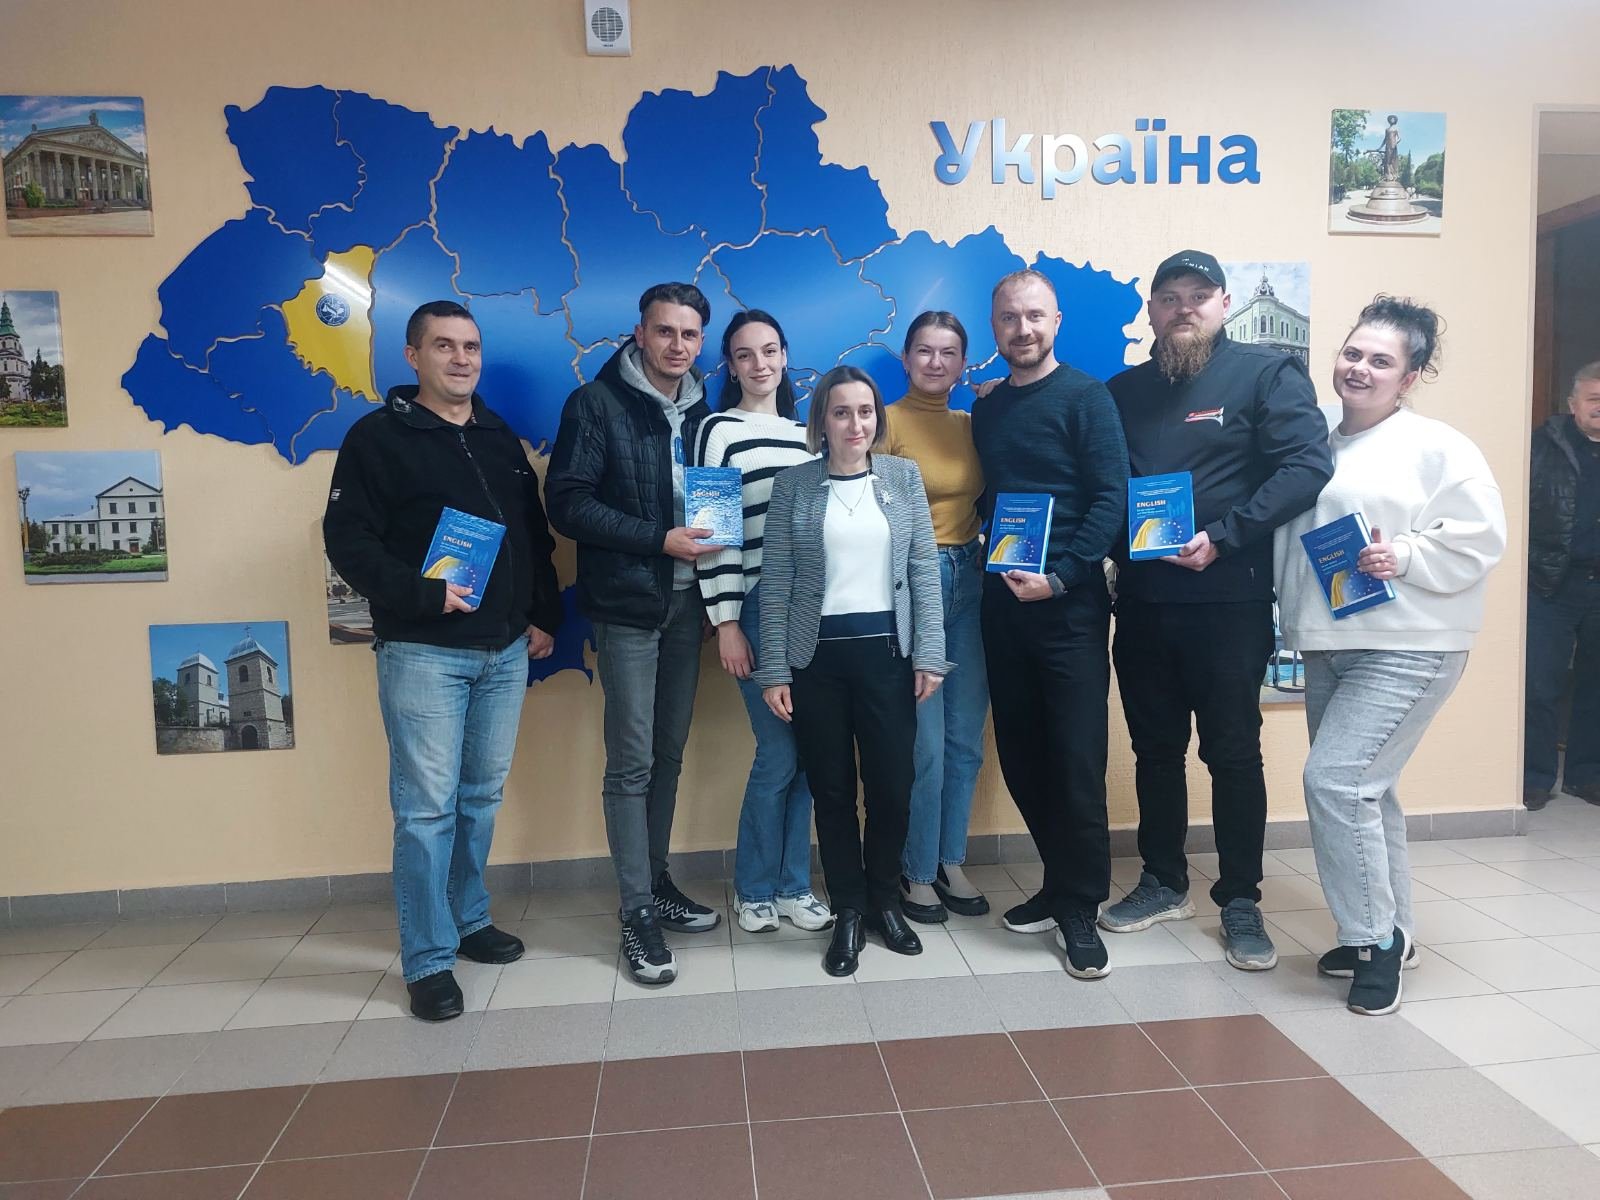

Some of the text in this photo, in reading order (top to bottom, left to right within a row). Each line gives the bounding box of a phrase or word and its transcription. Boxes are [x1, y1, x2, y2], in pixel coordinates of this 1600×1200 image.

[929, 117, 1261, 200] Україна
[1136, 500, 1166, 508] ENGLISH
[443, 536, 472, 548] ENGLISH
[1319, 550, 1345, 563] ENGLISH
